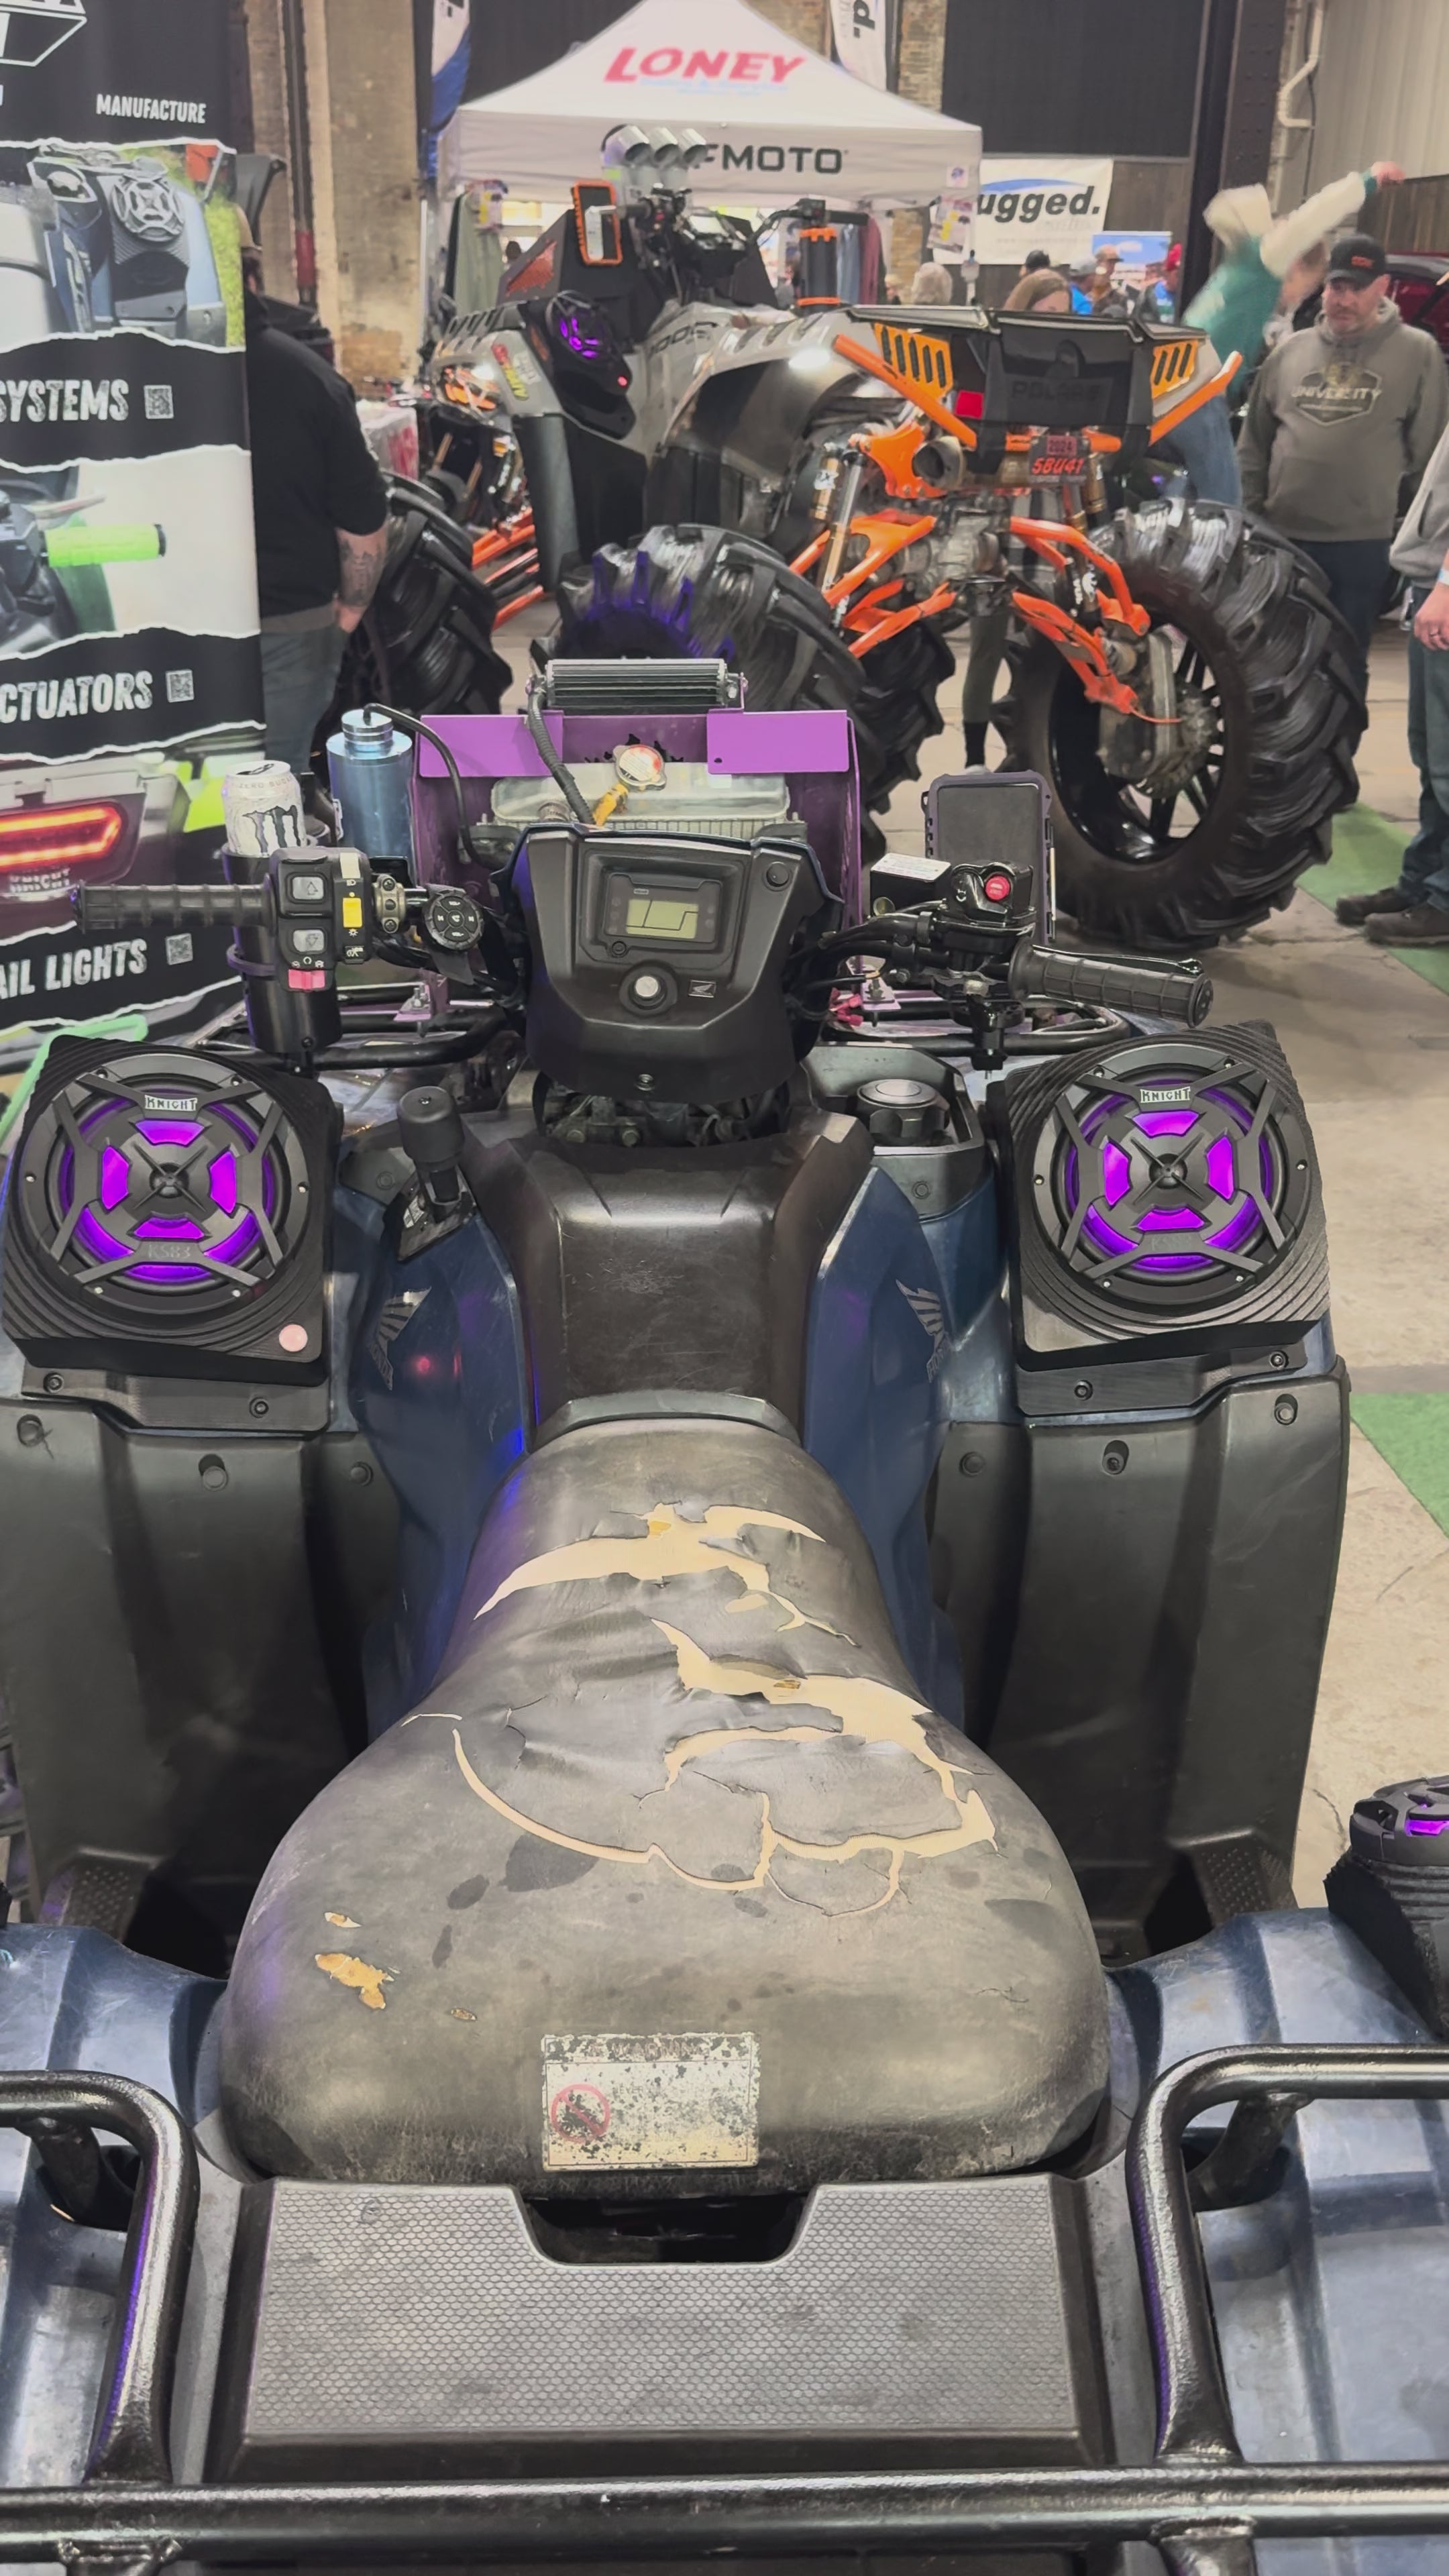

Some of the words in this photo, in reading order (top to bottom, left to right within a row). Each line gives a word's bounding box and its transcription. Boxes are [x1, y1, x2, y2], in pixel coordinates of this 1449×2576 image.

[604, 47, 804, 83] LONEY
[96, 93, 207, 123] MANUFACTURE
[704, 144, 843, 174] FMOTO
[977, 185, 1101, 223] ugged.
[45, 938, 147, 991] LIGHTS
[146, 1096, 197, 1111] KNIGHT
[1140, 1087, 1190, 1102] KNIGHT
